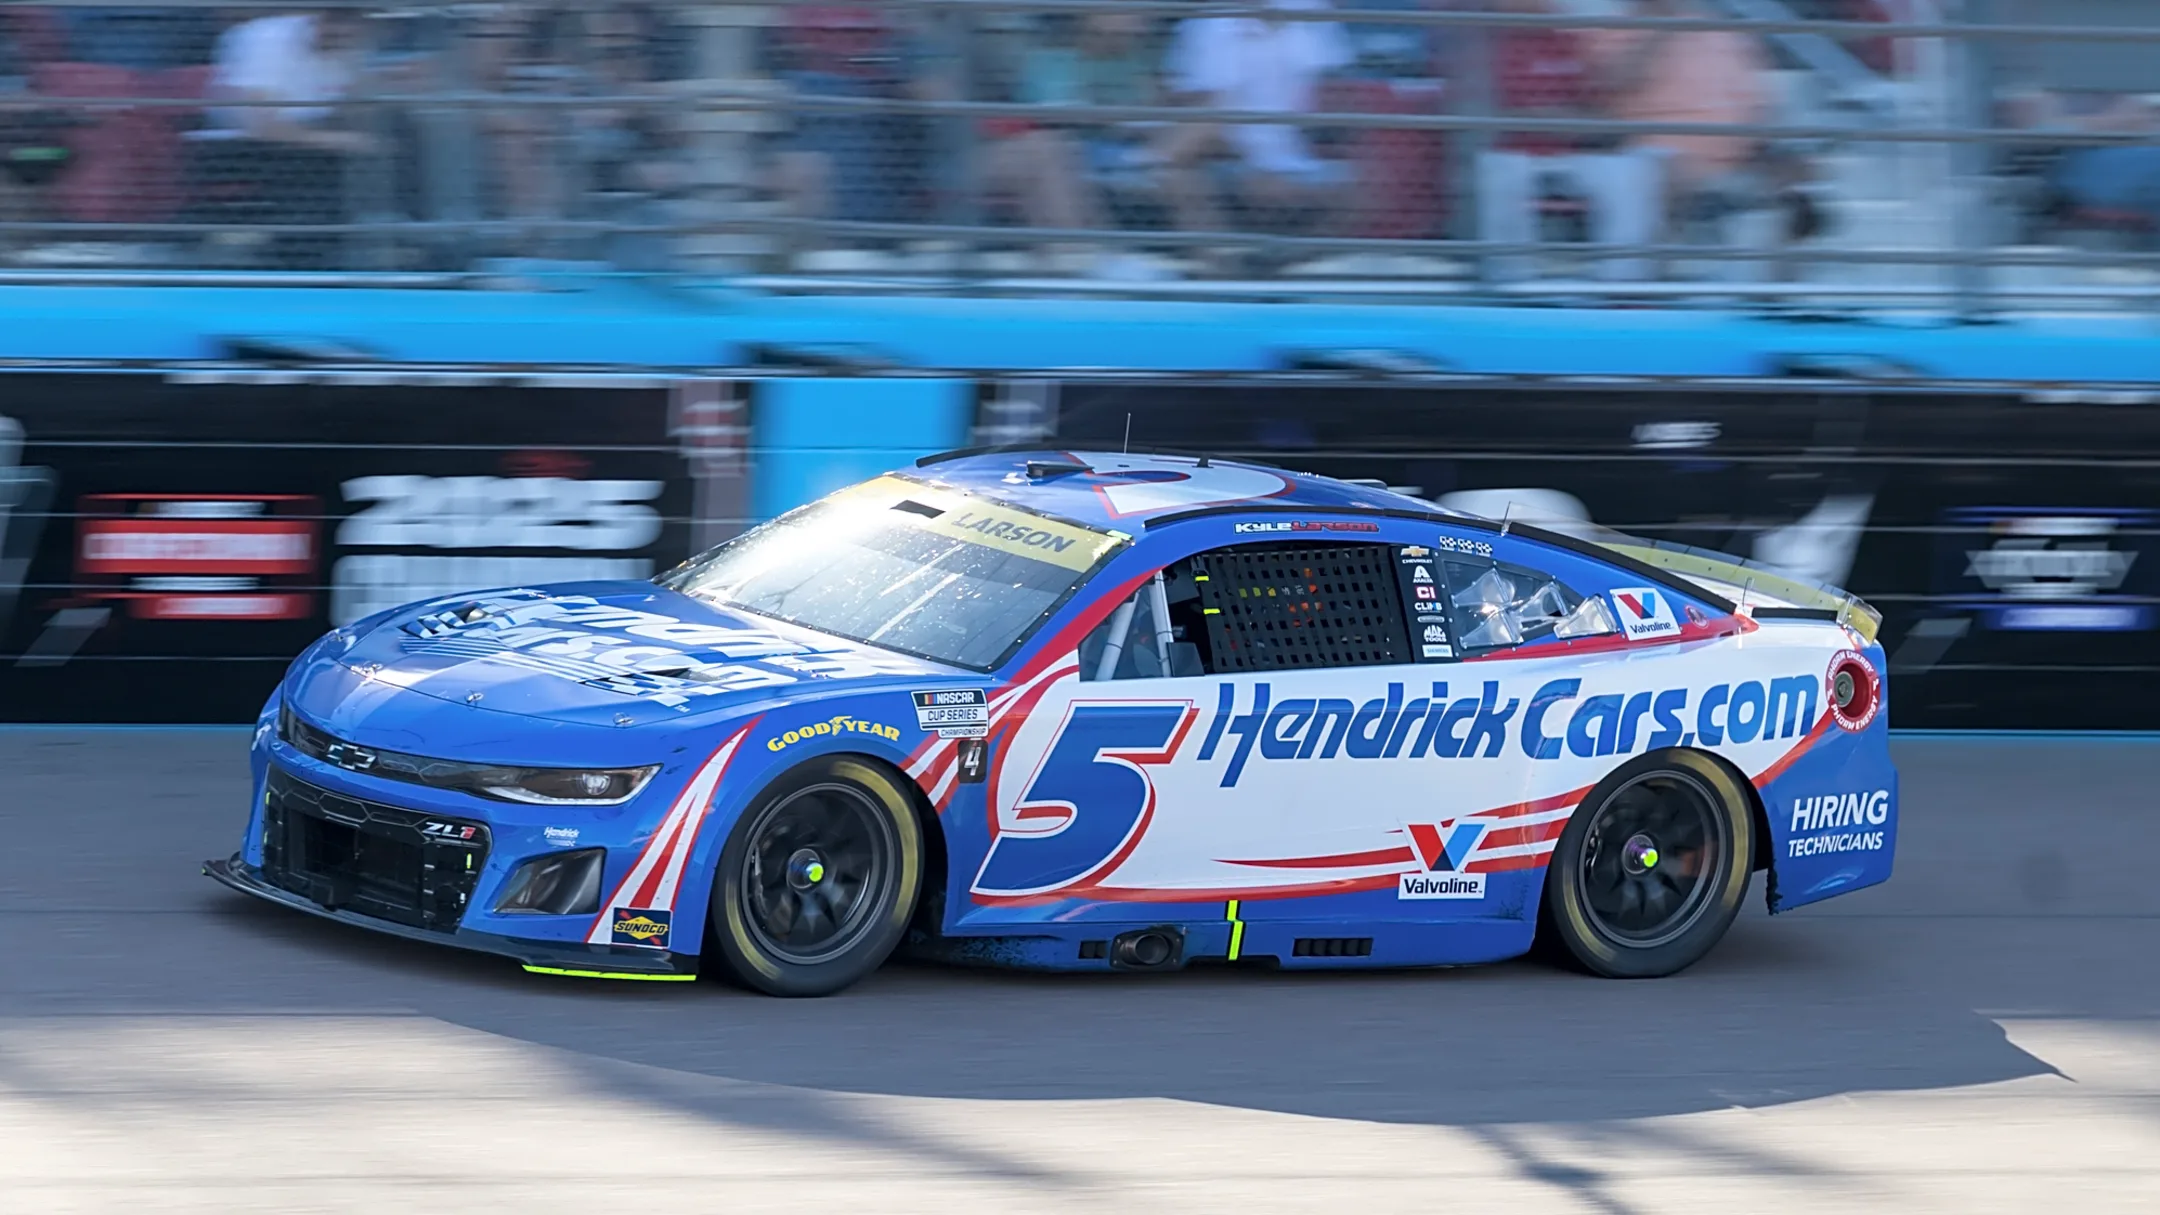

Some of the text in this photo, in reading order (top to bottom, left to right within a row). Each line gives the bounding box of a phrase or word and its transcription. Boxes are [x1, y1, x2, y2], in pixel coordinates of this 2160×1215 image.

[951, 513, 1076, 553] LARSON
[1416, 586, 1436, 599] CI
[1630, 621, 1671, 634] Valvoline
[936, 692, 975, 705] NASCAR
[928, 709, 978, 721] CUP SERIES
[940, 728, 987, 738] CHAMPIONSHIP
[964, 746, 981, 776] 4
[970, 701, 1194, 895] 5
[1790, 790, 1889, 832] HIRING
[422, 822, 476, 839] ZL1
[544, 826, 580, 838] Hendrick
[1788, 831, 1884, 858] TECHNICIANS
[1404, 878, 1479, 894] Valvoline
[616, 922, 666, 934] SUNOCO
